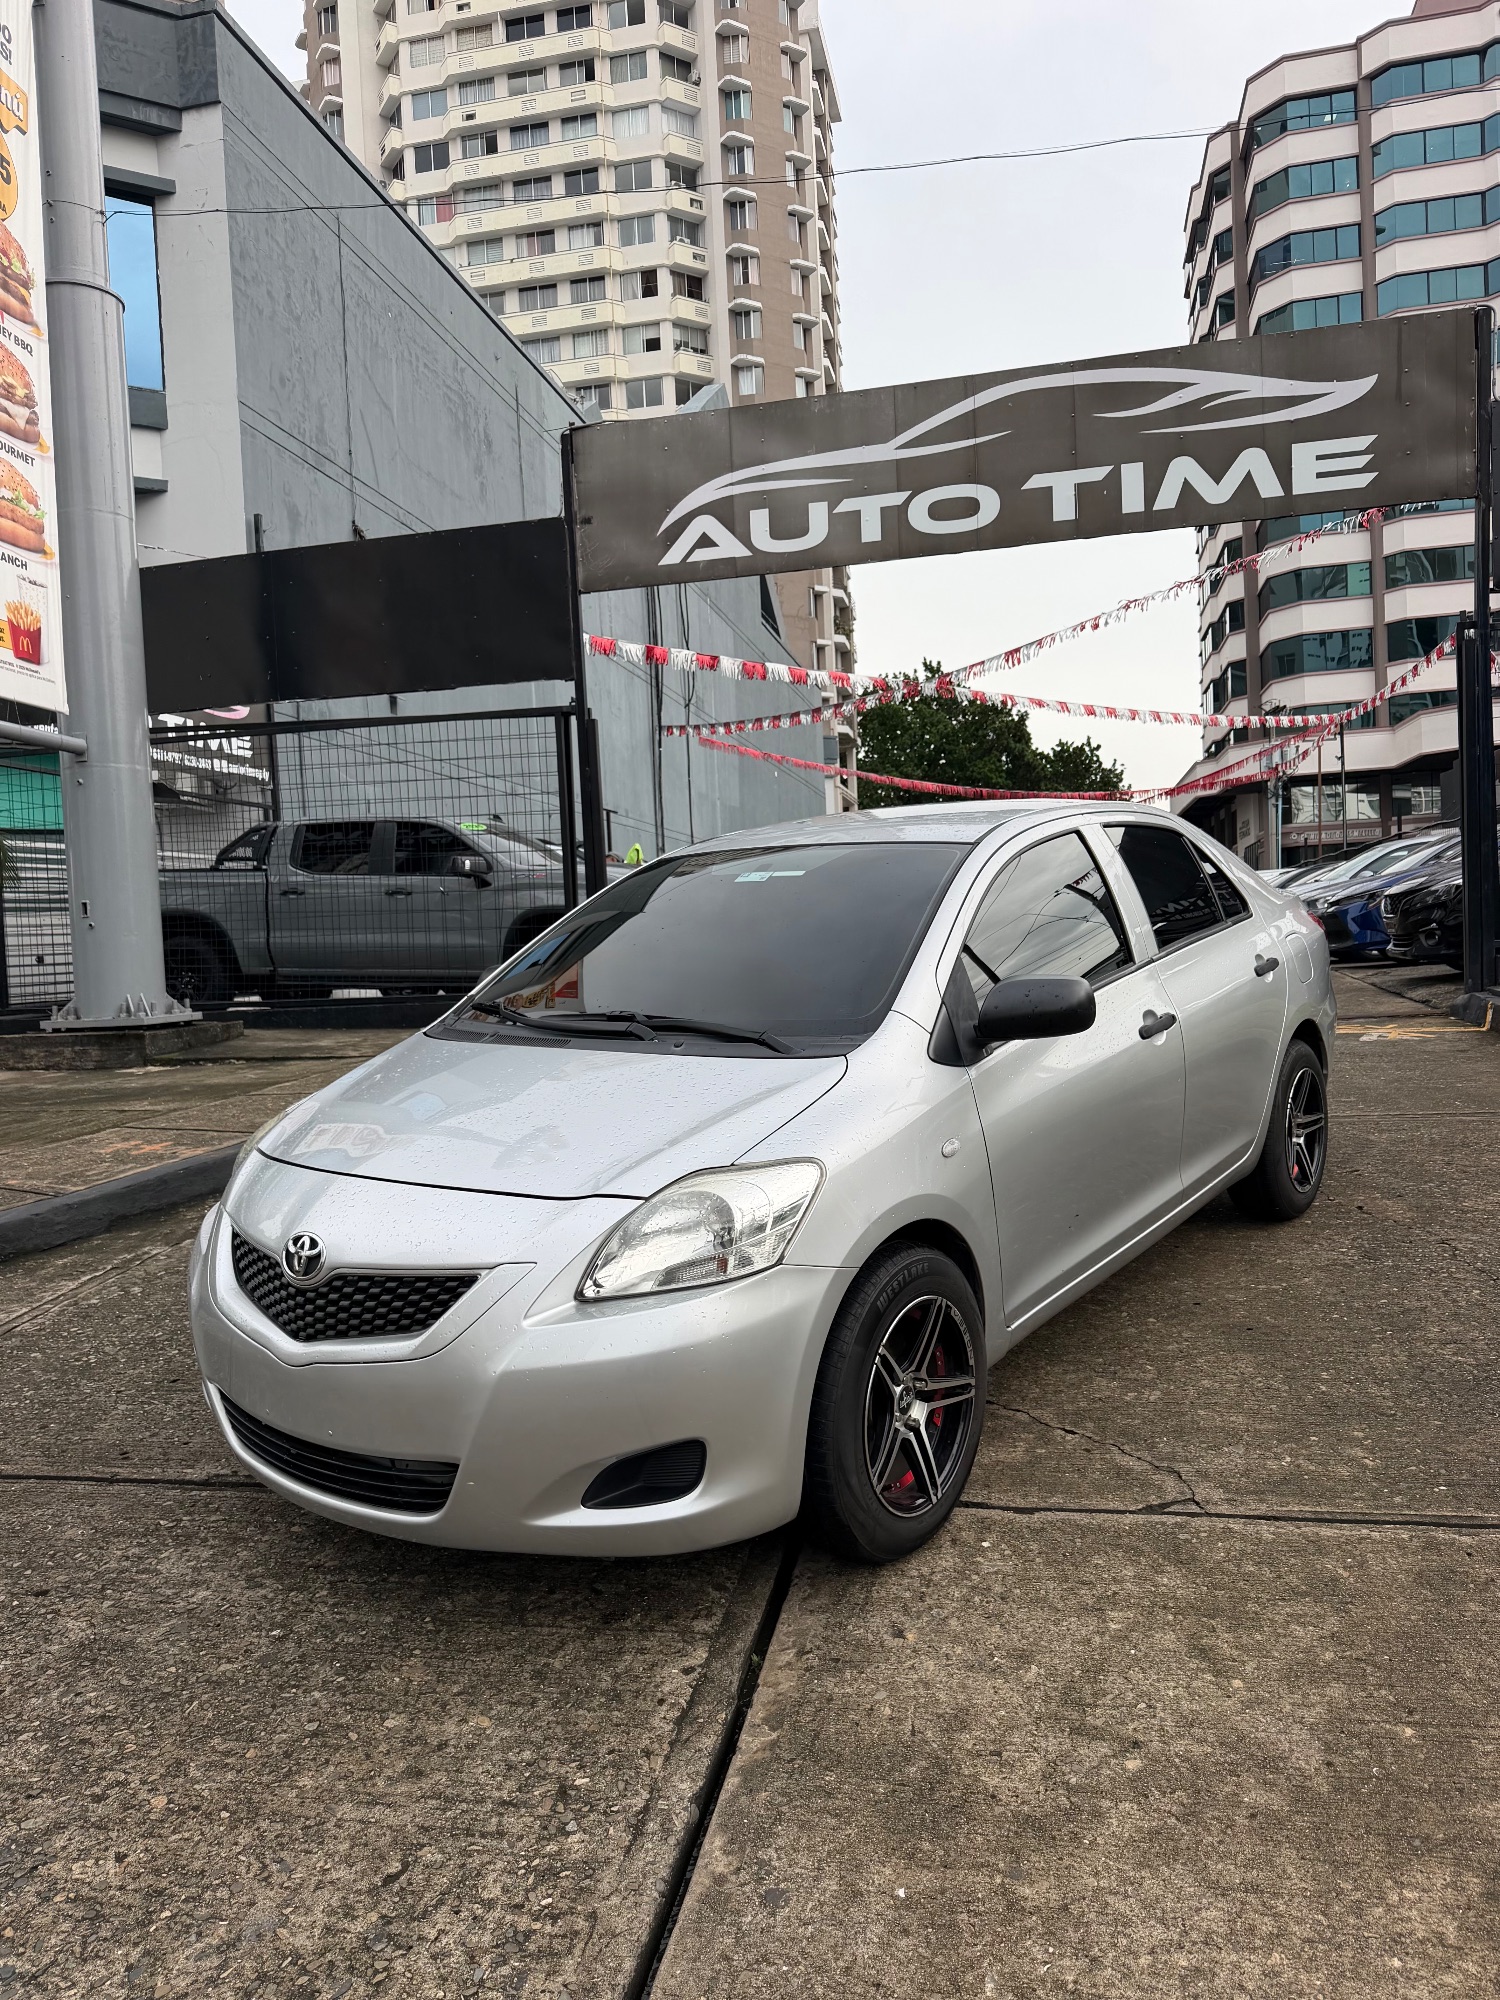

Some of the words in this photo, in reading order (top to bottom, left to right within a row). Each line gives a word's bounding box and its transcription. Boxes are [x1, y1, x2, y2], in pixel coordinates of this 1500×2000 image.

[14, 334, 34, 358] BBQ
[657, 484, 1001, 567] AUTO
[1021, 434, 1379, 522] TIME
[0, 551, 28, 571] ANCH
[877, 1262, 930, 1312] WESTLAKE
